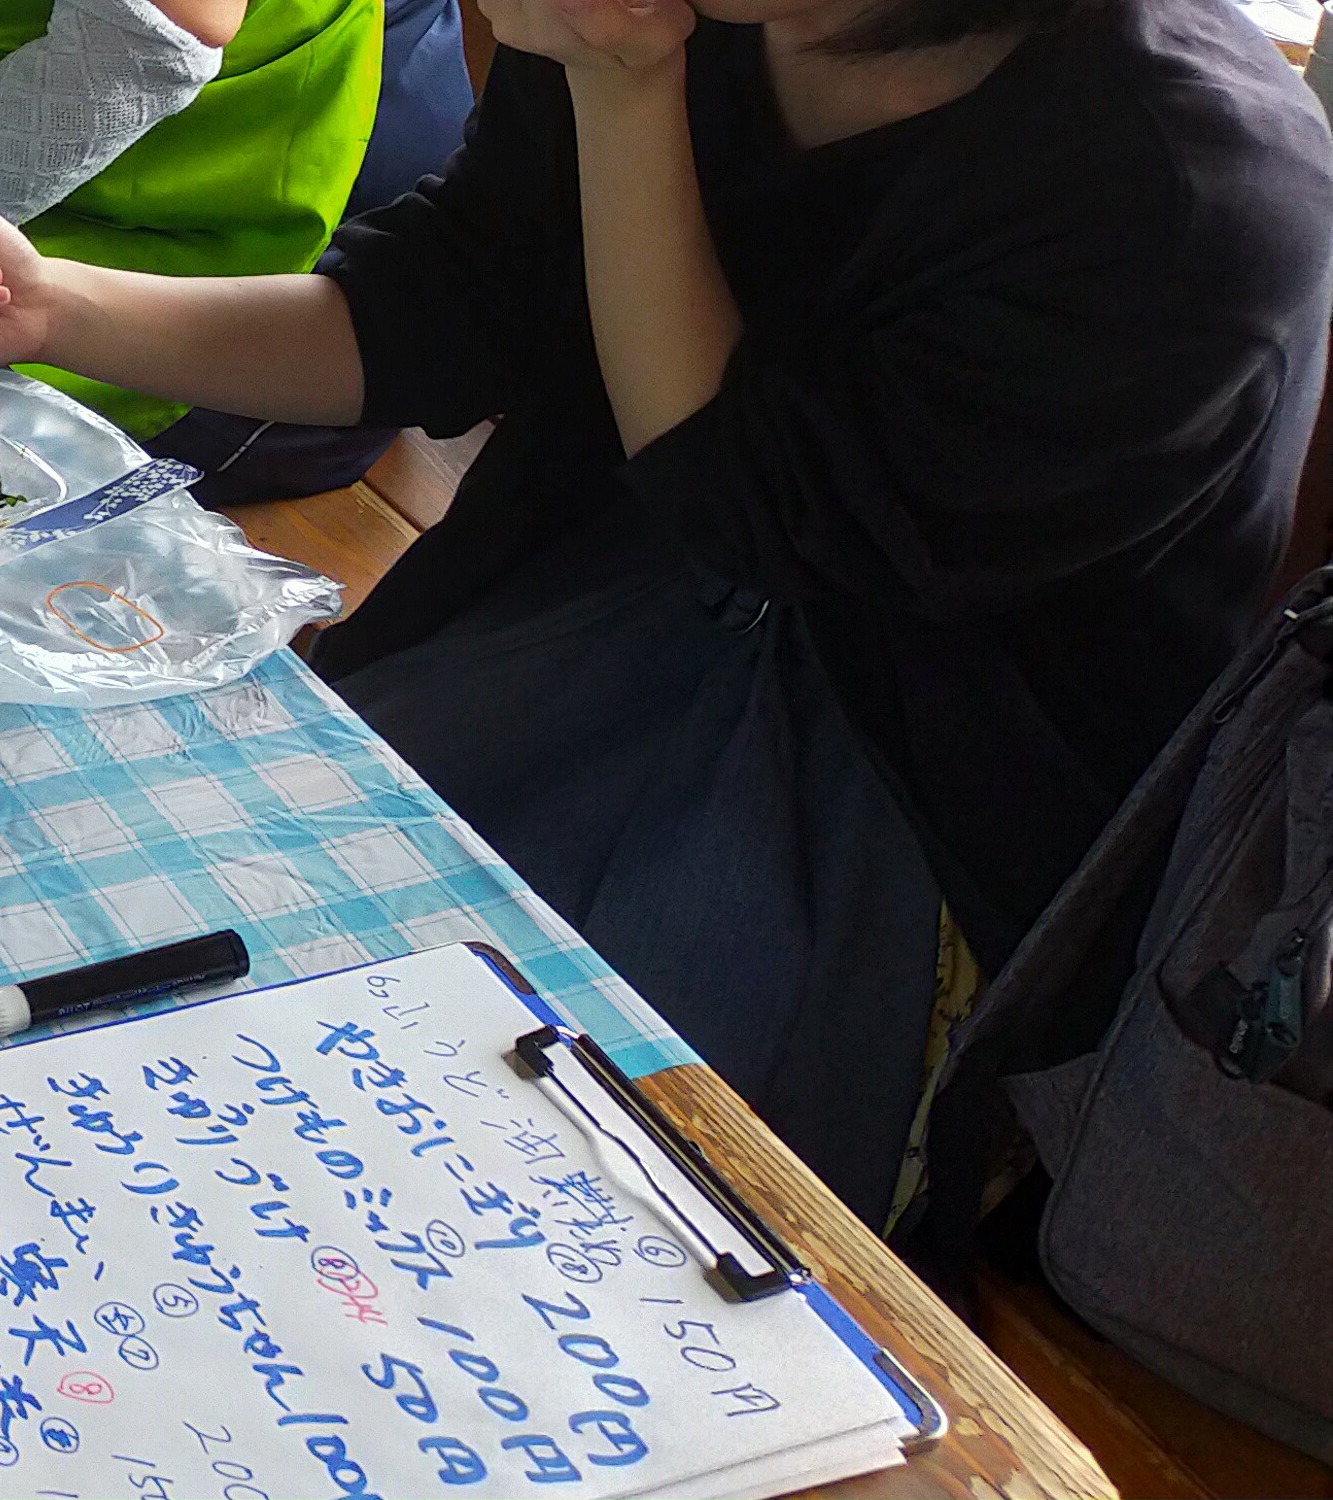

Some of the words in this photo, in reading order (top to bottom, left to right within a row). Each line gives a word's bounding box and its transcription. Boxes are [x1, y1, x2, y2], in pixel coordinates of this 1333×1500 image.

[360, 1352, 489, 1485] 50円
[416, 1314, 583, 1484] 100円
[522, 1291, 652, 1470] 200円
[111, 1453, 174, 1500] 15
